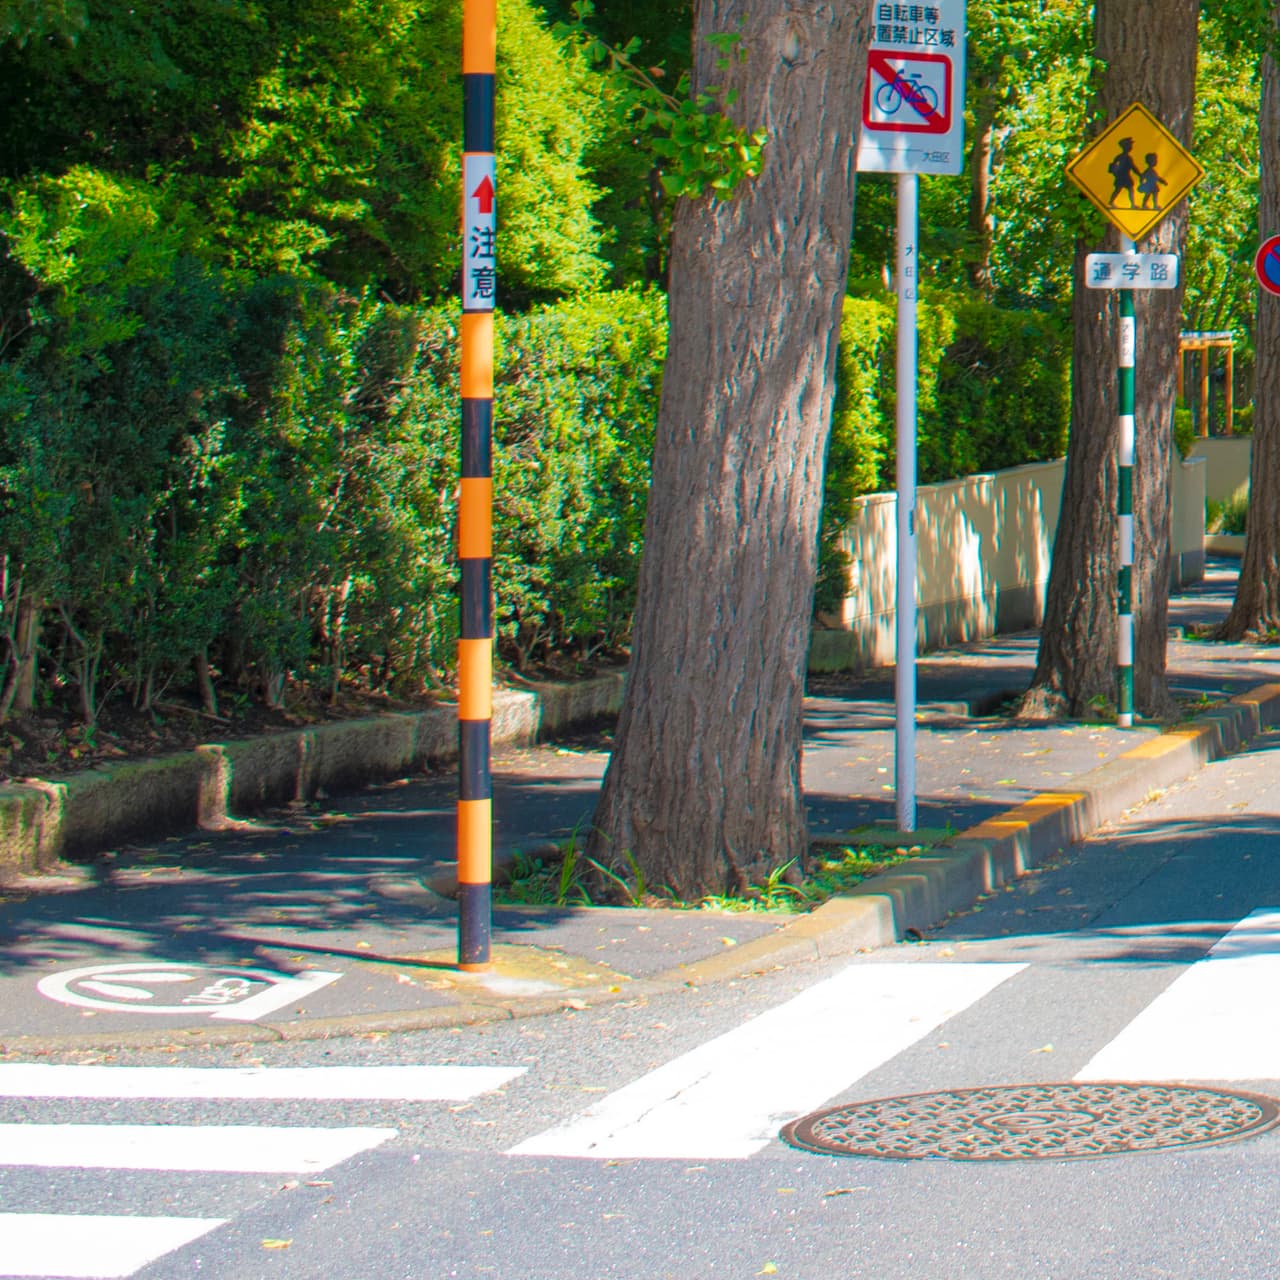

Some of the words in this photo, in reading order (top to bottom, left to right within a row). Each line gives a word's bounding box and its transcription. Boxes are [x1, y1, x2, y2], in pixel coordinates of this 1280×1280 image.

[878, 2, 939, 25] 自転車等
[469, 226, 496, 300] 注意
[1093, 261, 1169, 282] 通学路
